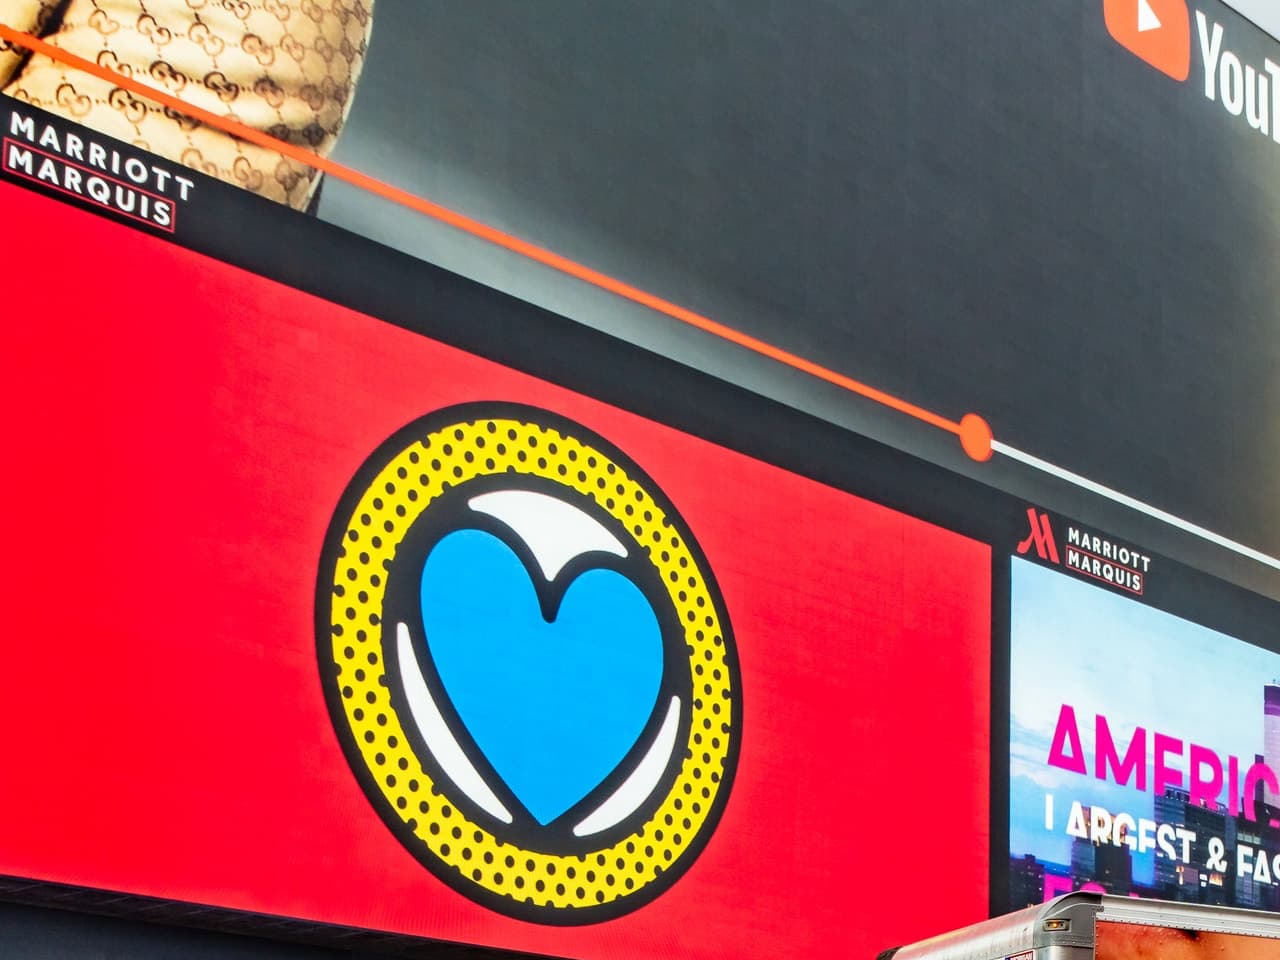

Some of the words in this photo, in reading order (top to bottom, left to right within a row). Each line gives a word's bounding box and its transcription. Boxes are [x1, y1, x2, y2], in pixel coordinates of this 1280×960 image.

[8, 145, 171, 226] MARQUIS
[11, 111, 194, 201] MARRIOTT
[1068, 527, 1151, 573] MARRIOTT
[1068, 550, 1142, 591] MARQUIS
